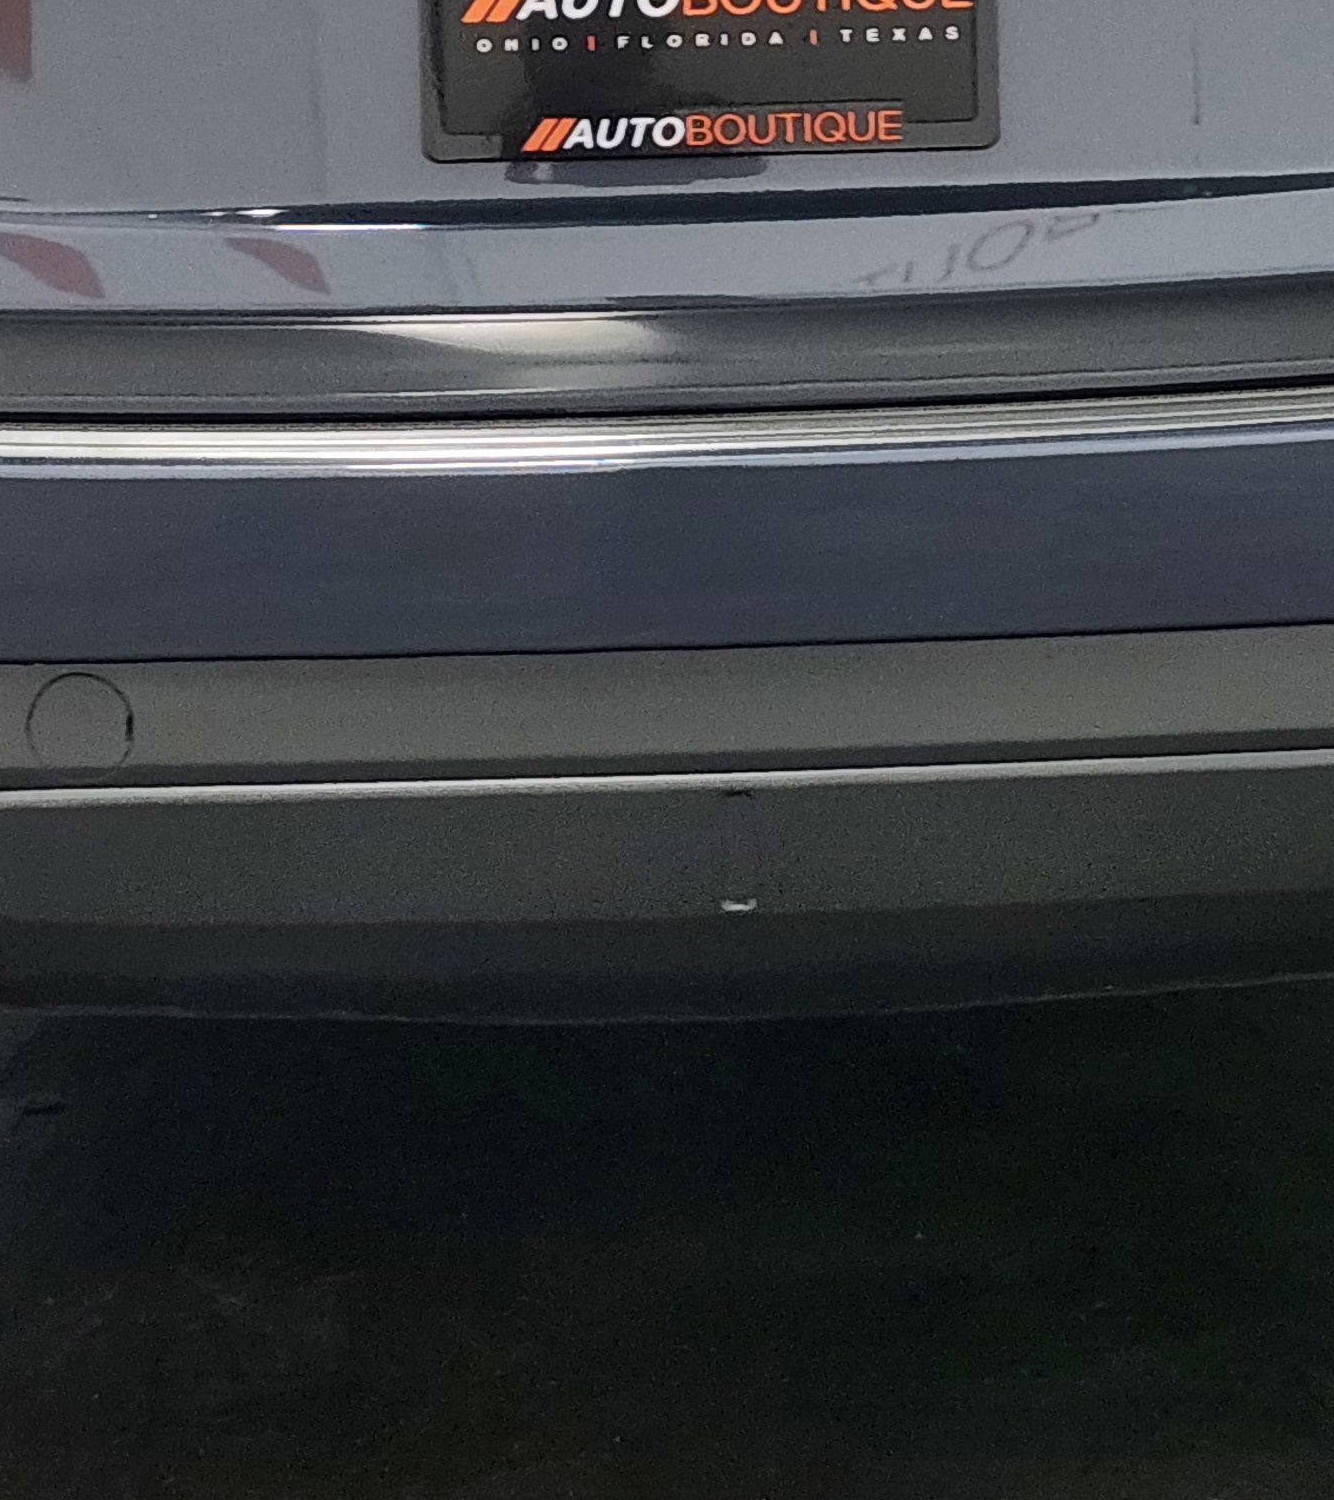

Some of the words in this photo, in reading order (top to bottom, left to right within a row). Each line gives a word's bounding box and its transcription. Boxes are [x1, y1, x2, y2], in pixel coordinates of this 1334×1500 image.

[475, 35, 569, 53] OHIO
[616, 30, 784, 51] FLORIDA
[838, 24, 961, 43] TEXAS
[563, 109, 904, 152] AUTOBOUTIQUE
